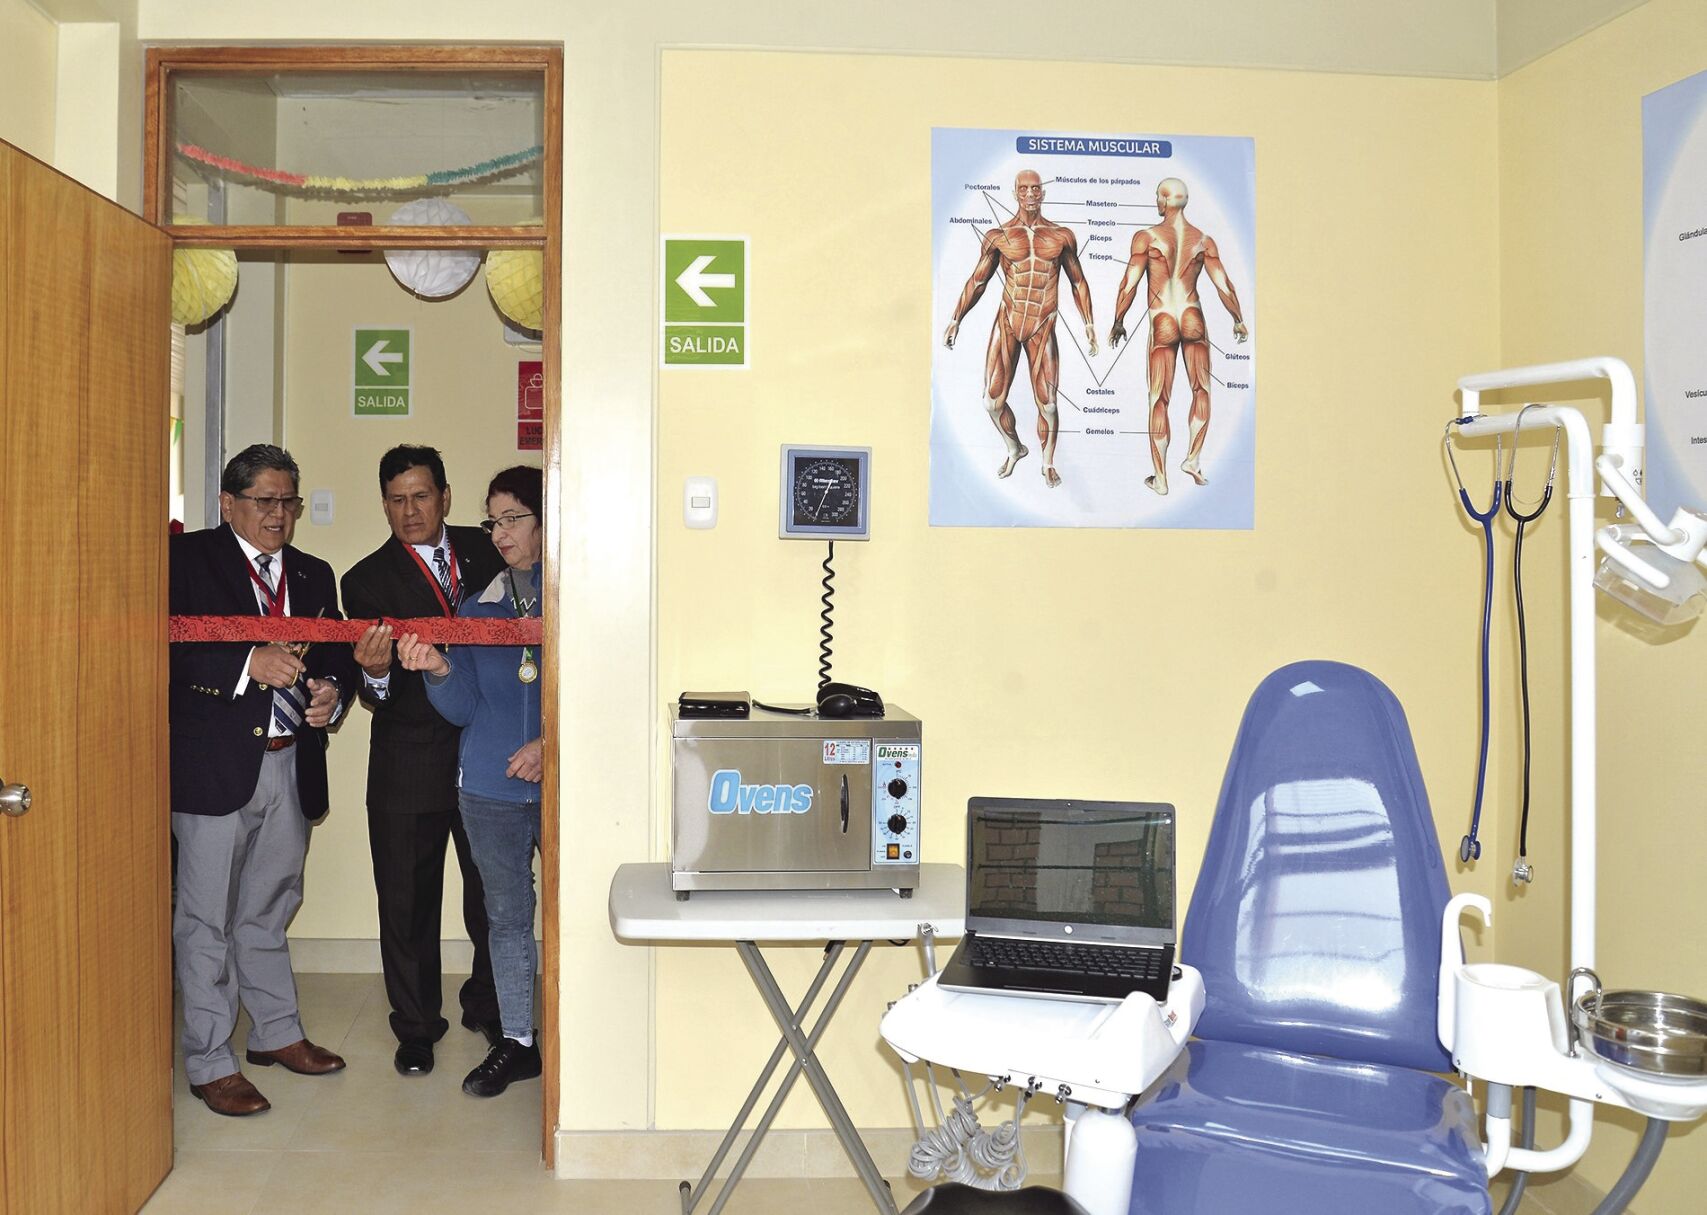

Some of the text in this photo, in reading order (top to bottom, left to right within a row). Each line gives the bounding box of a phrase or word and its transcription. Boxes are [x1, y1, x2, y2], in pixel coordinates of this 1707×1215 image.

[1028, 138, 1161, 155] SISTEMA MUSCULAR
[1055, 176, 1087, 184] Músculos
[1110, 178, 1141, 186] párpados
[964, 183, 1001, 191] Pectorales
[1085, 199, 1118, 207] Masetero
[949, 216, 993, 225] Abdominales
[1087, 218, 1116, 227] Trapecio
[669, 336, 740, 354] SALIDA
[1225, 353, 1250, 361] Glúteos
[1086, 387, 1115, 395] Costales
[357, 395, 406, 408] SALIDA
[1082, 406, 1120, 415] Cuádriceps
[1085, 427, 1114, 435] Gemelos
[824, 742, 836, 756] 12
[878, 746, 909, 758] Ovens
[707, 768, 814, 815] Ovens
